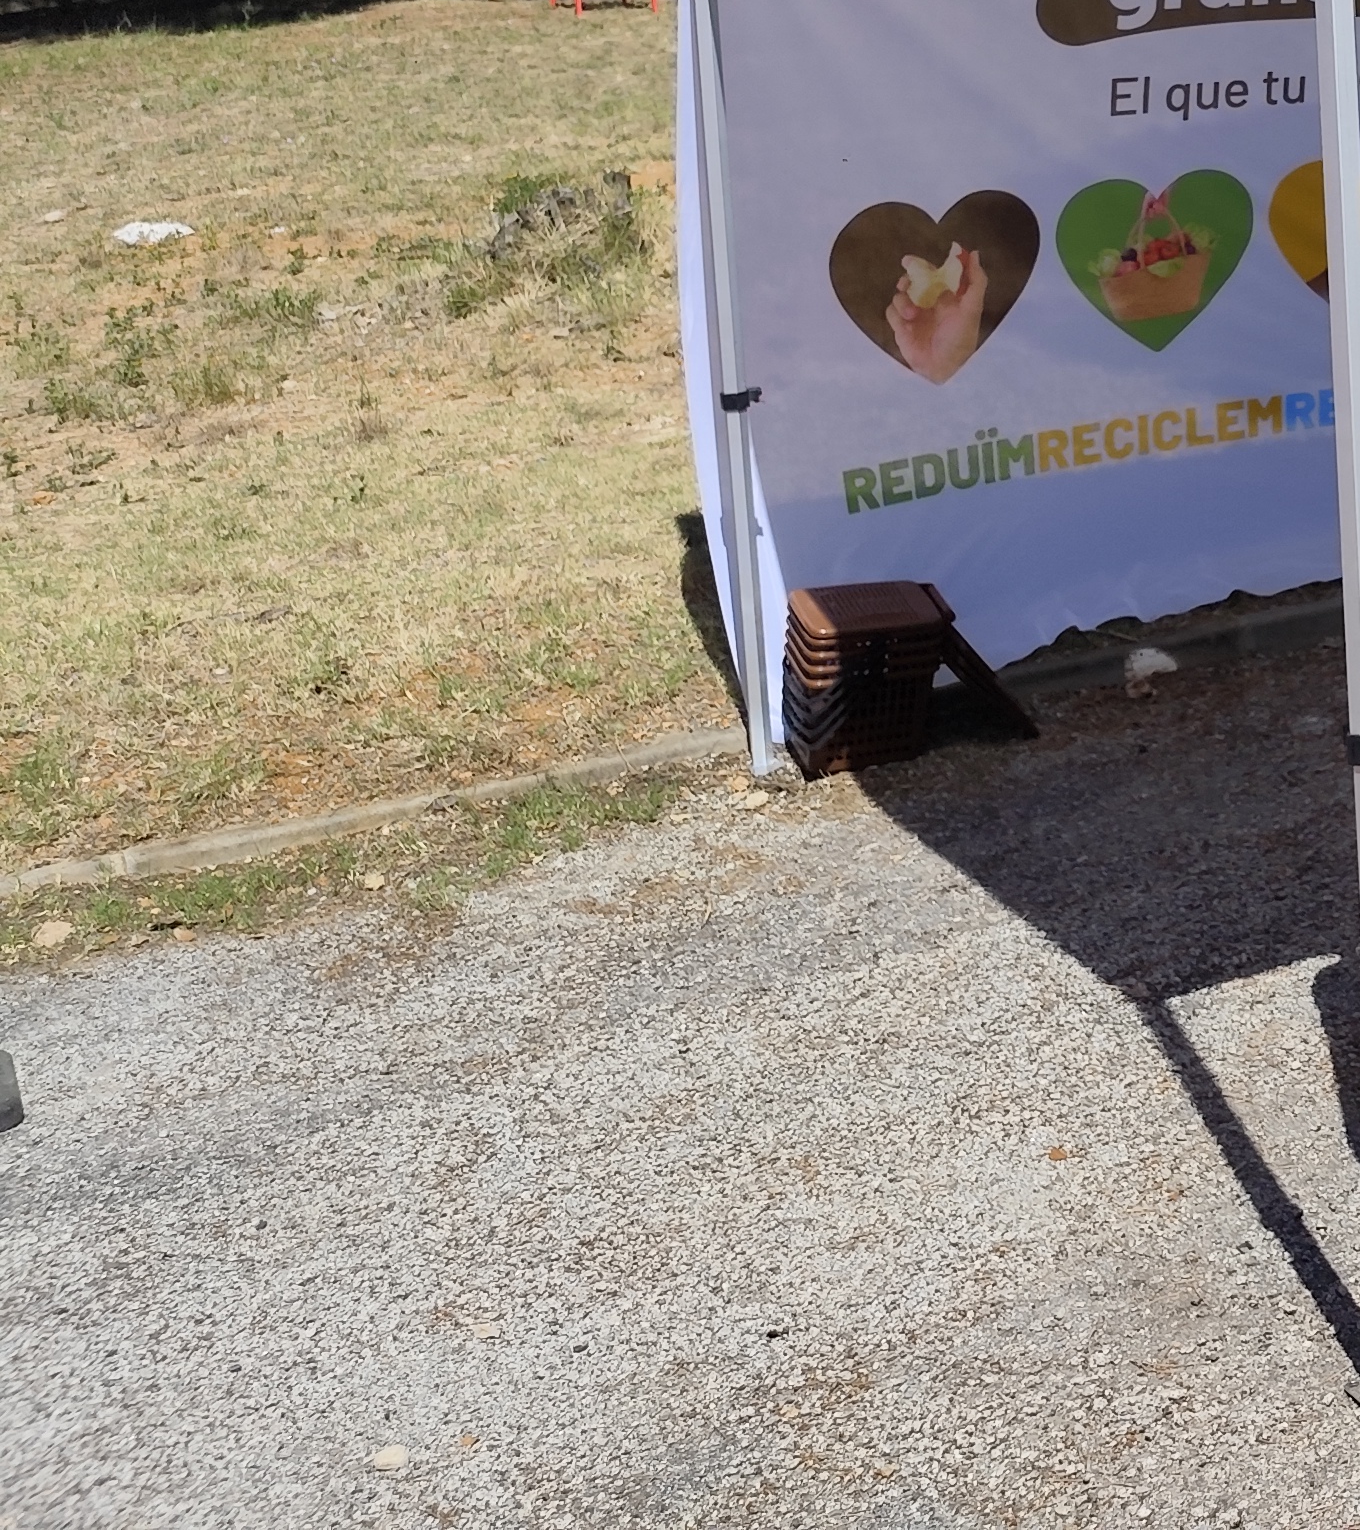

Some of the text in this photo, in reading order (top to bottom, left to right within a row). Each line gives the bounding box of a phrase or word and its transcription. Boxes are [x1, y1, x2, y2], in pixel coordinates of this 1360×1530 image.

[1110, 76, 1150, 117] El
[1166, 79, 1249, 121] que
[1262, 71, 1306, 105] tu
